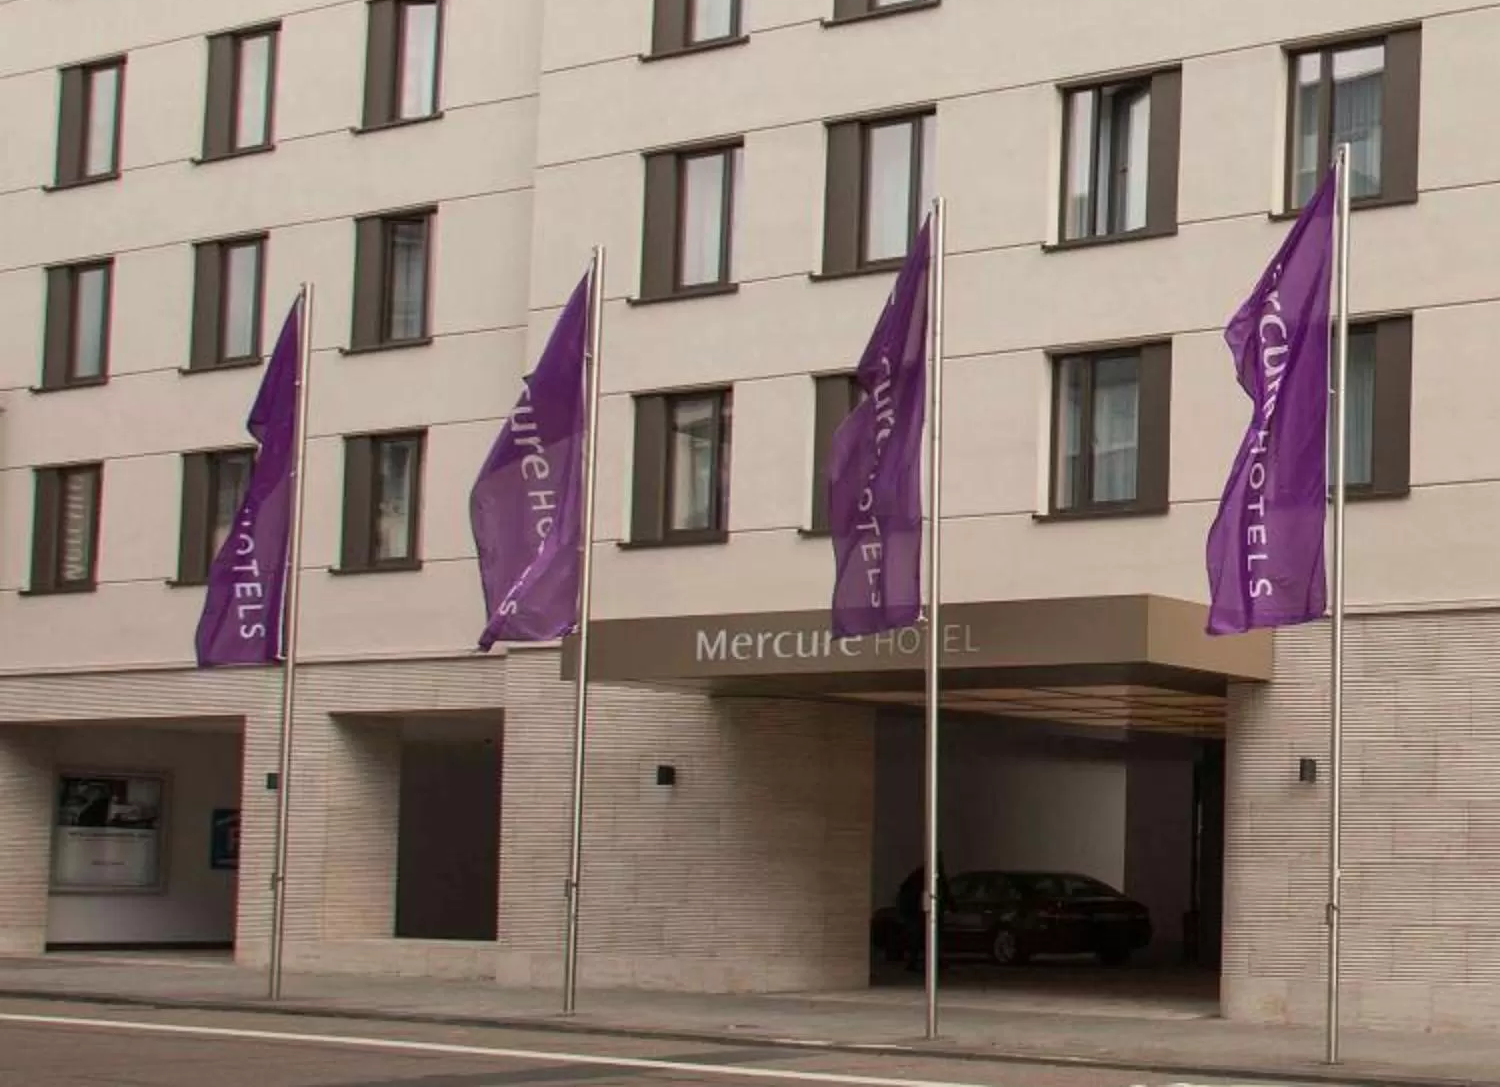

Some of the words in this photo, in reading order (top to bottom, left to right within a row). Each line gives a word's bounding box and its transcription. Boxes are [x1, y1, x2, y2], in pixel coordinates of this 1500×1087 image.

[232, 507, 266, 640] OTELS
[1247, 430, 1273, 598] HOTELS
[695, 627, 863, 662] Mercure
[874, 624, 981, 657] HOEL
